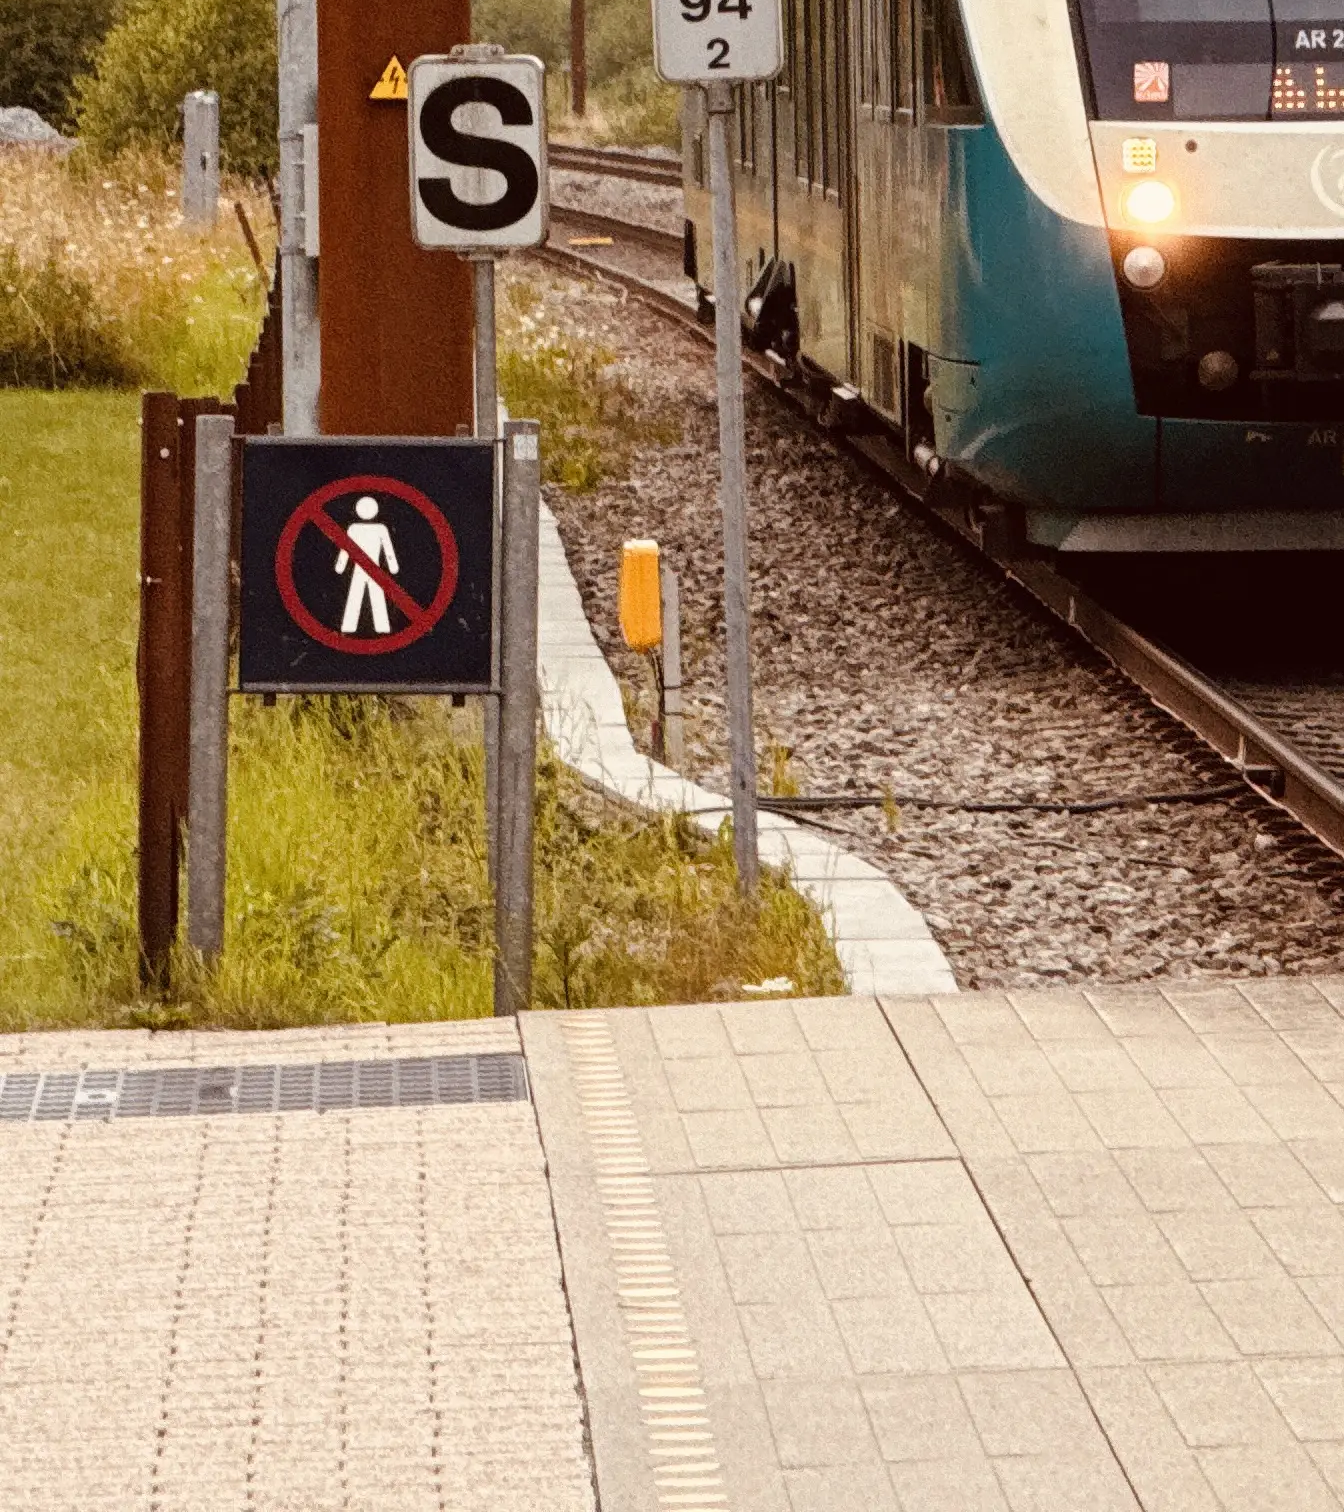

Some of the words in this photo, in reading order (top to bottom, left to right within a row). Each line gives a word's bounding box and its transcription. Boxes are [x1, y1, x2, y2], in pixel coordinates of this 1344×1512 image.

[1295, 29, 1327, 49] AR
[706, 37, 731, 69] 2
[417, 76, 539, 231] S
[1307, 429, 1338, 445] AR
